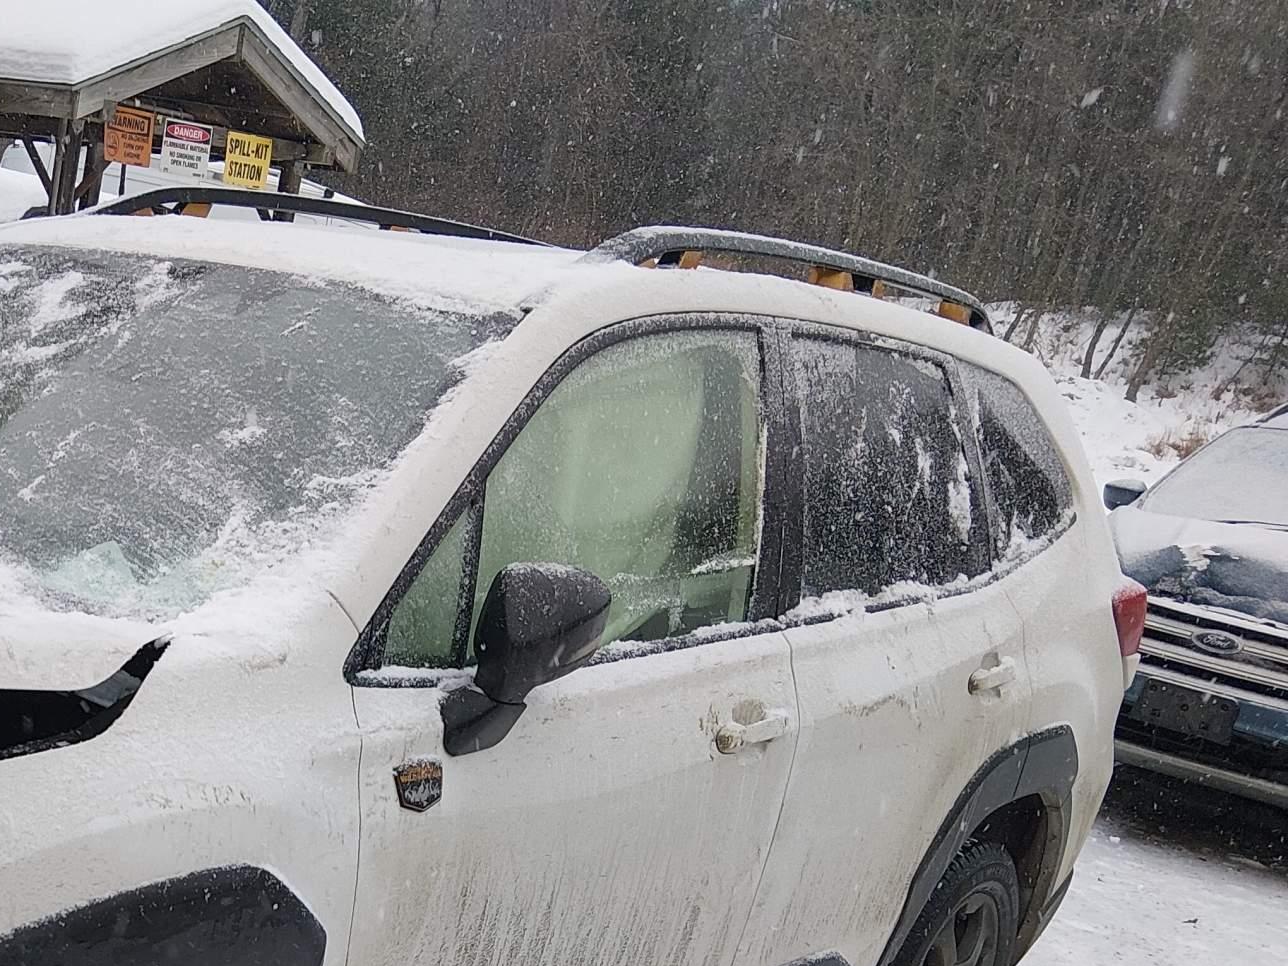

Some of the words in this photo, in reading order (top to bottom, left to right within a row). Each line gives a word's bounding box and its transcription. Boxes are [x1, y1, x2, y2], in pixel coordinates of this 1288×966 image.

[174, 126, 203, 140] DANGER
[229, 137, 269, 160] SPILL-KIT
[176, 152, 195, 161] SMOKING
[228, 161, 263, 182] STATION
[1203, 634, 1231, 649] Ford
